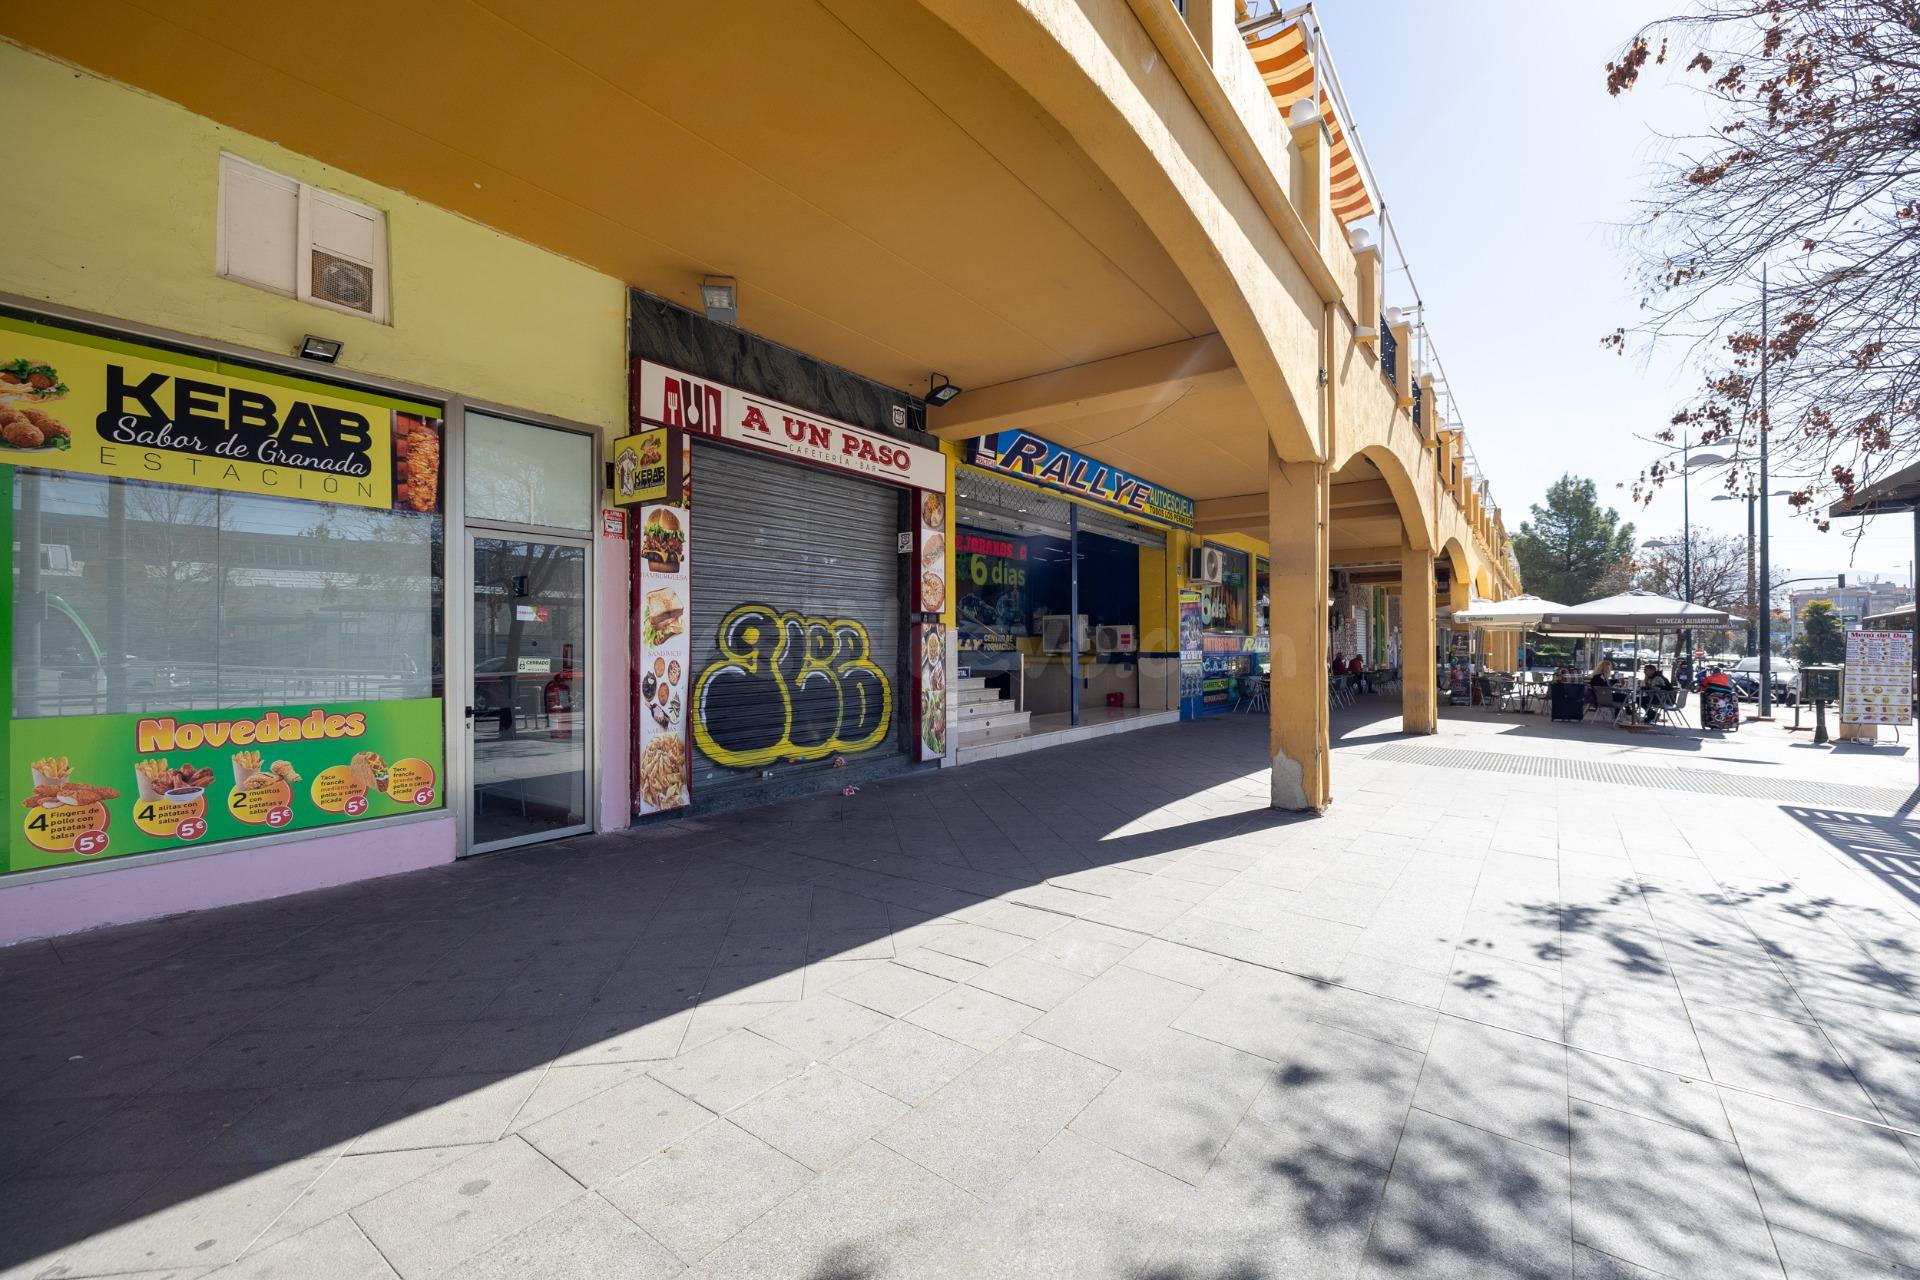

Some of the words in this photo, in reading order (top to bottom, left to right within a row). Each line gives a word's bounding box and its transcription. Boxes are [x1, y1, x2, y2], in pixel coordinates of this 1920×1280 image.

[106, 363, 371, 447] KEBAB
[113, 415, 207, 451] Sabor
[215, 437, 249, 459] de
[258, 439, 368, 477] Granada
[741, 405, 771, 435] A
[782, 415, 831, 451] UN
[842, 433, 911, 471] PASO
[789, 443, 850, 467] CAFETERÍA
[100, 446, 373, 499] ESTACIÓN
[634, 466, 665, 484] KEBAB
[996, 433, 1152, 511] RALLYE
[1150, 487, 1193, 519] AUTOESCUELA
[971, 553, 988, 586] 6
[137, 710, 366, 753] Novedades
[158, 804, 181, 812] alitas
[233, 792, 247, 809] 2
[249, 801, 276, 809] patatas
[50, 809, 86, 819] Fingers
[51, 818, 75, 827] pollo
[77, 815, 94, 823] con
[138, 805, 156, 821] 4
[158, 810, 190, 819] patatas
[158, 817, 180, 825] salsa
[28, 814, 49, 832] 4
[51, 824, 86, 834] patatas
[51, 832, 75, 840] salsa
